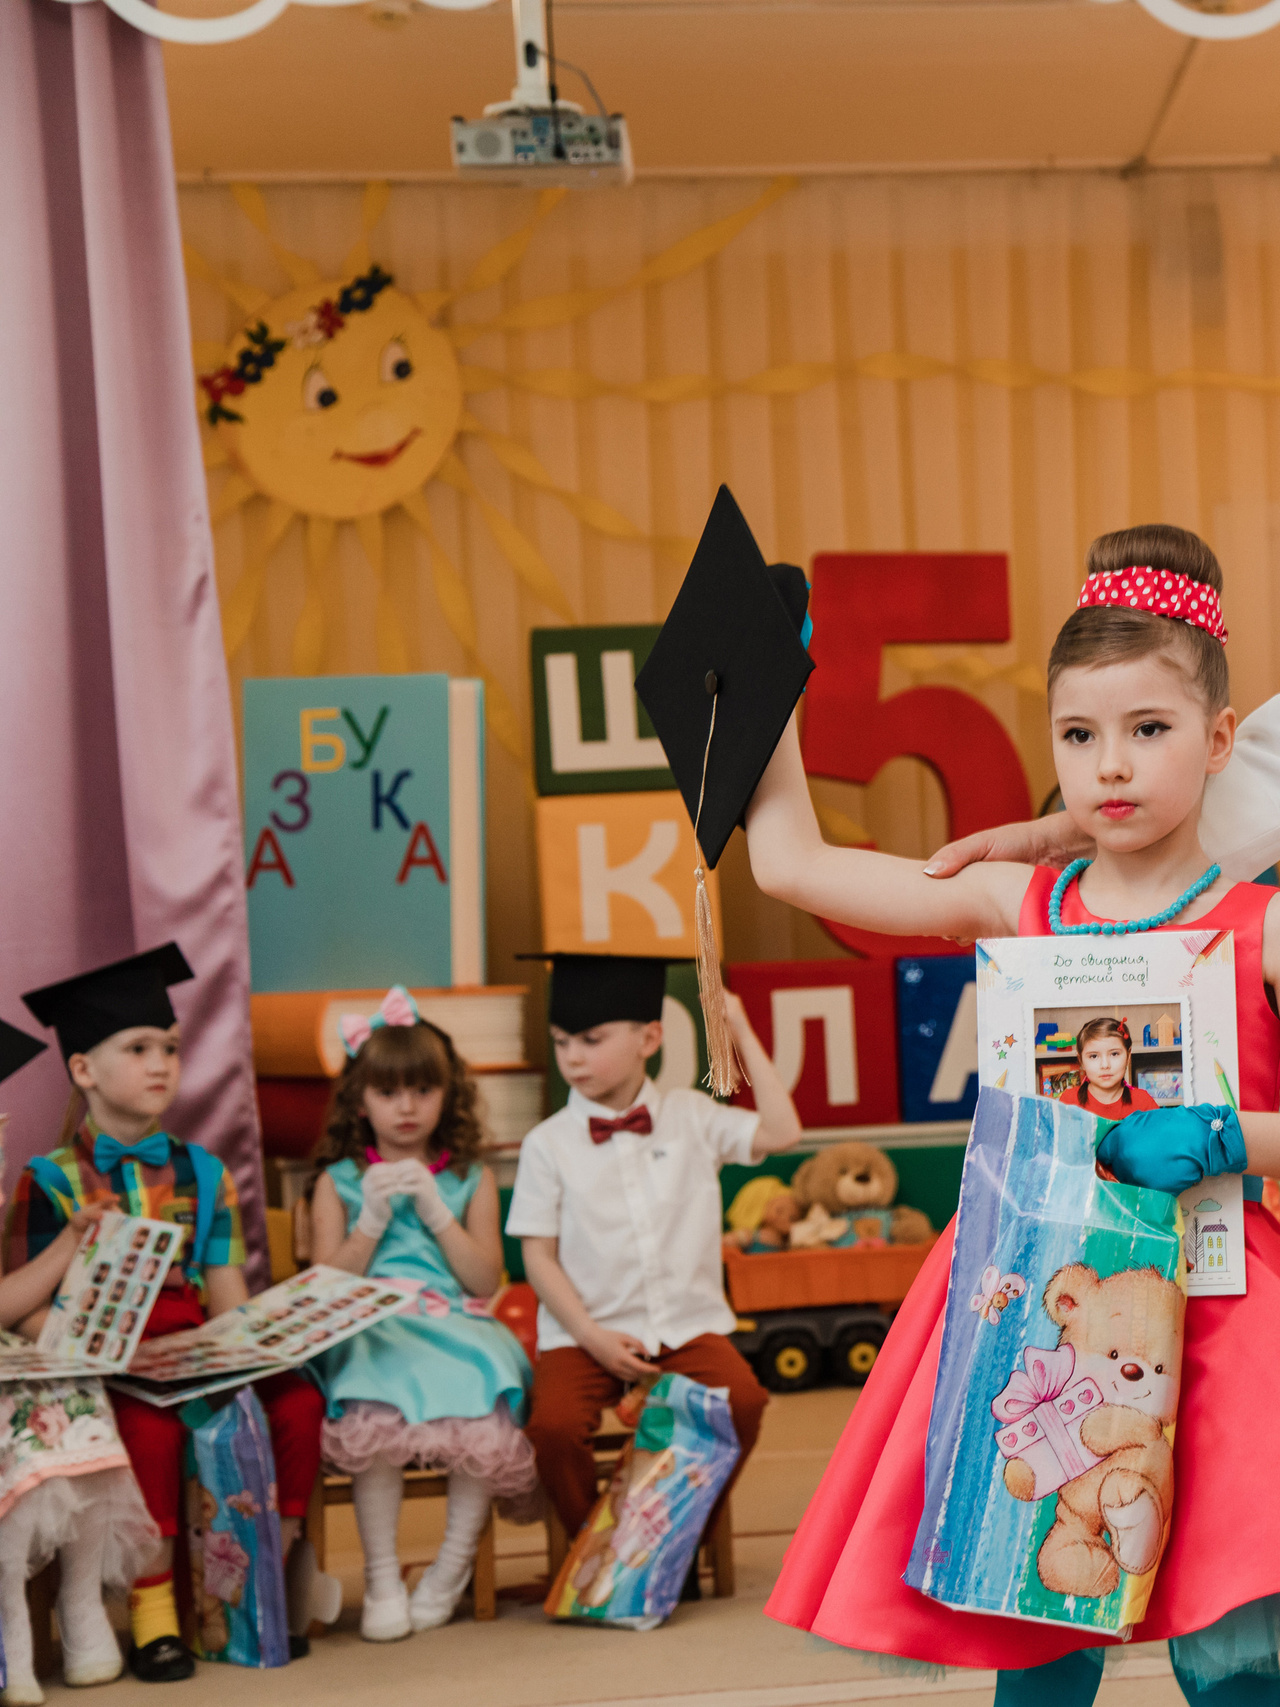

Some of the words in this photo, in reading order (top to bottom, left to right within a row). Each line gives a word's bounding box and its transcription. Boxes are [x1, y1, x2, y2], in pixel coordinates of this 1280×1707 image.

[803, 551, 1034, 958] 5
[577, 820, 685, 943] К
[1053, 954, 1073, 968] До
[1080, 953, 1149, 972] свидания,
[1053, 970, 1114, 991] детский
[1121, 966, 1149, 988] сад!
